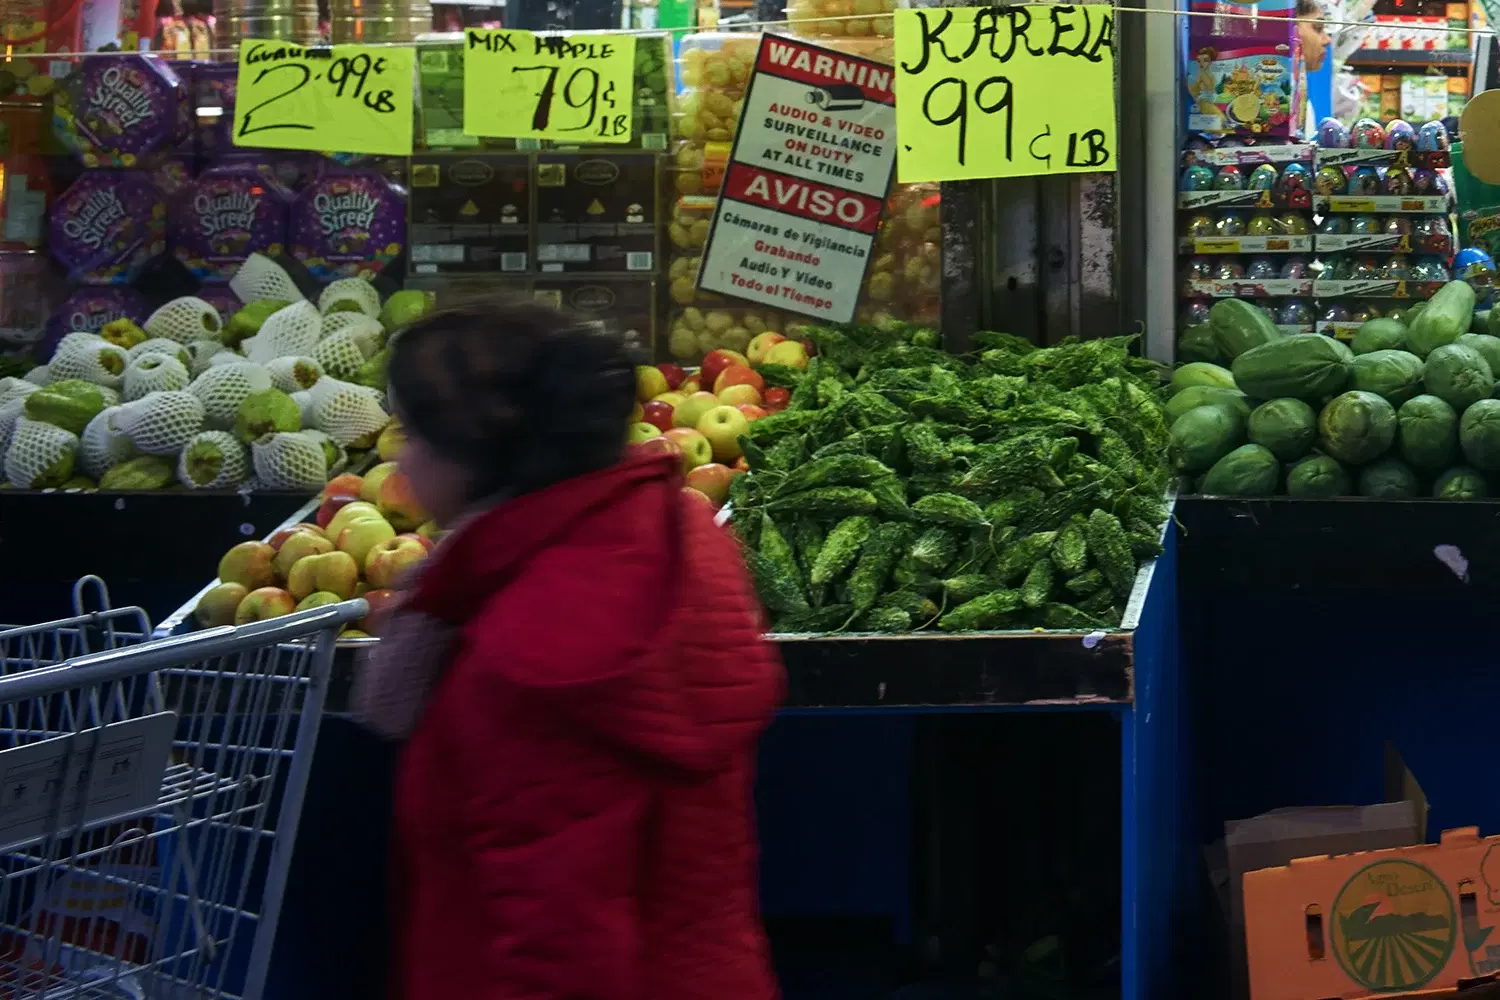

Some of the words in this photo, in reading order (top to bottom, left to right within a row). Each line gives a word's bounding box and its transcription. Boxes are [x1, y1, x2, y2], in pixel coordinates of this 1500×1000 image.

[468, 31, 516, 53] MIX
[769, 42, 896, 97] WARNIN
[89, 86, 143, 129] Street
[102, 66, 155, 119] Quality
[363, 90, 396, 113] LB
[597, 115, 628, 137] LB
[763, 117, 883, 157] SURVEILLANCE
[768, 102, 819, 124] AUDIO
[821, 116, 833, 128] &
[838, 119, 885, 140] VIDEO
[785, 138, 807, 153] ON
[810, 144, 854, 165] DUTY
[1066, 128, 1109, 167] LB
[762, 148, 783, 162] AT
[784, 155, 813, 171] ALL
[817, 162, 864, 183] TIMES
[63, 185, 117, 238] Quality
[194, 191, 261, 216] Quality
[314, 191, 380, 214] Quality
[744, 175, 865, 223] AVISO
[81, 198, 126, 250] Street
[200, 211, 256, 237] Street
[320, 211, 377, 235] Street
[754, 239, 821, 266] Grabando
[783, 227, 800, 241] de
[802, 231, 865, 258] Vigilancia
[739, 256, 778, 276] Audio
[781, 266, 791, 279] Y
[731, 273, 763, 292] Todo
[766, 284, 778, 295] el
[782, 287, 833, 310] Tiempo
